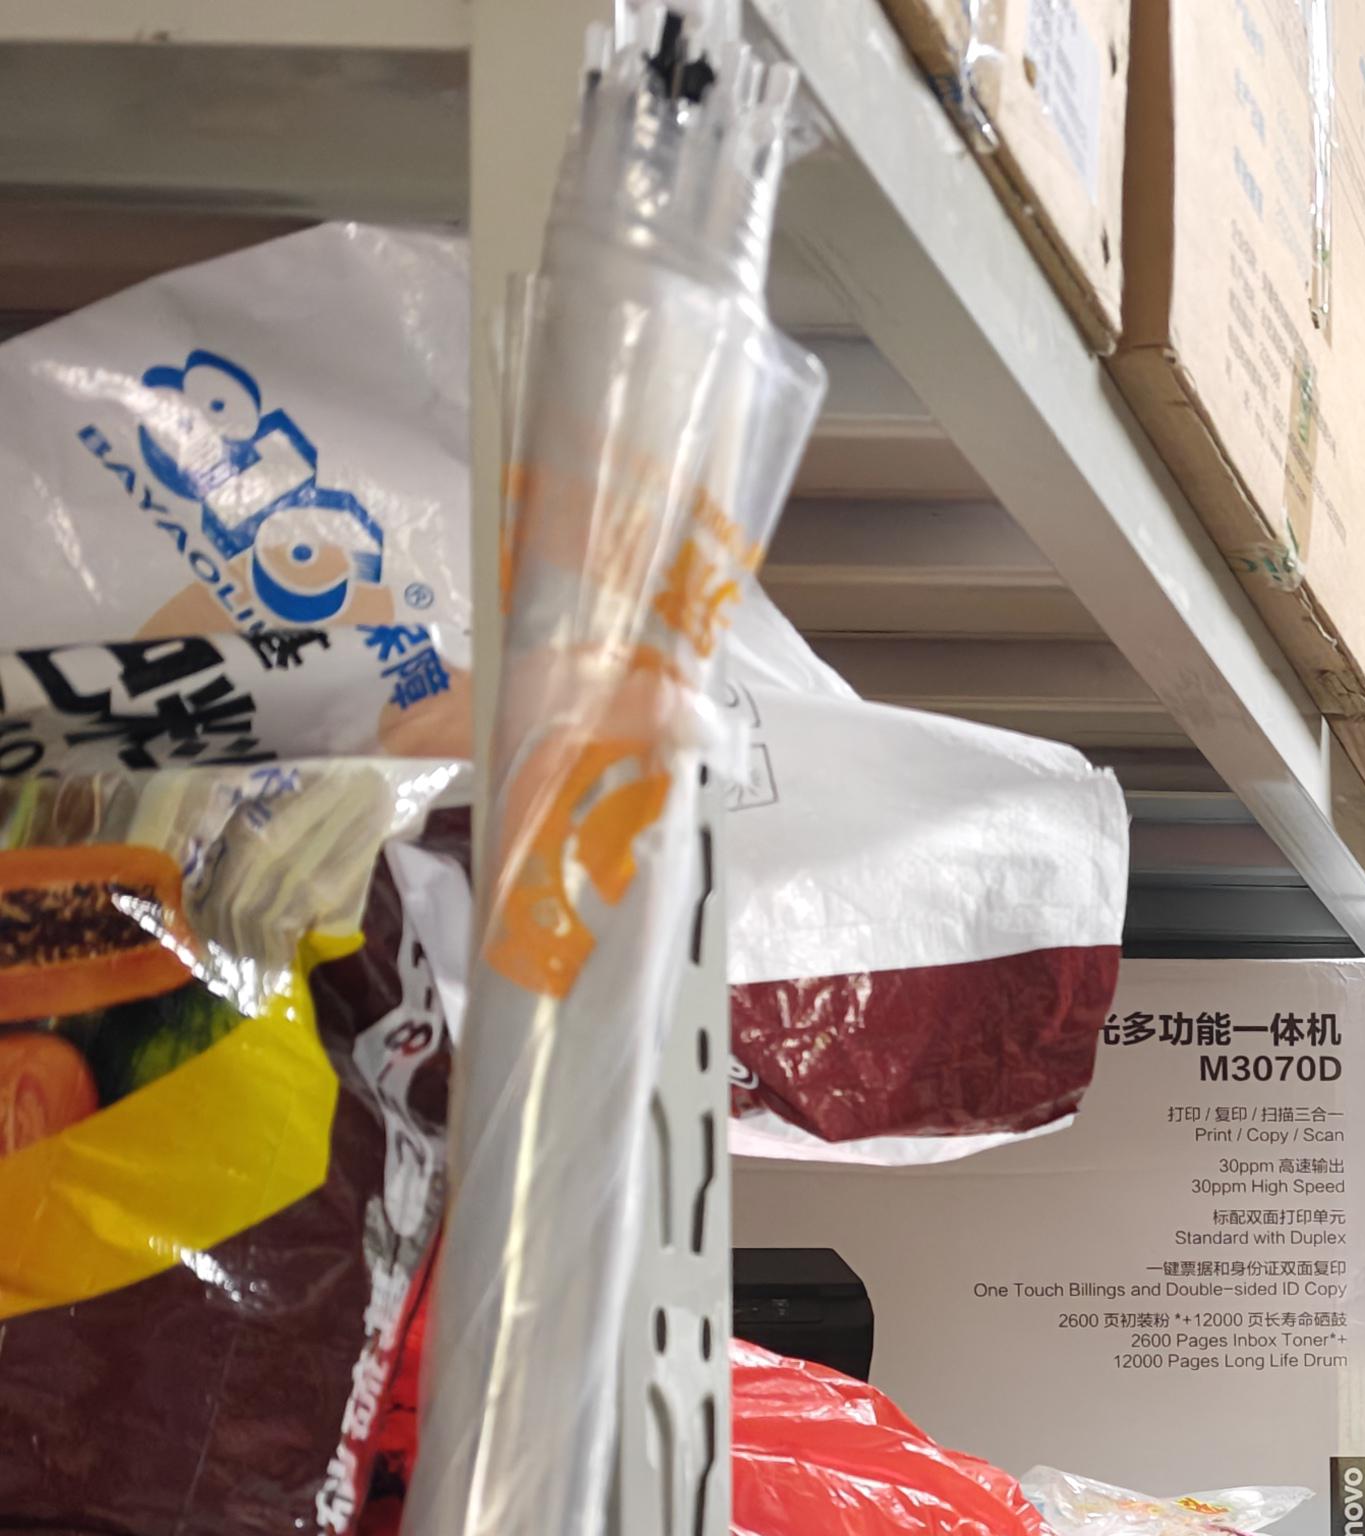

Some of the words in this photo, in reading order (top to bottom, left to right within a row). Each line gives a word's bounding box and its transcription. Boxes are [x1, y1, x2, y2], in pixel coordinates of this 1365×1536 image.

[1200, 1055, 1342, 1081] M3070D
[1168, 1106, 1200, 1122] 打印
[1215, 1106, 1247, 1122] 复印
[1261, 1106, 1344, 1122] 扫描三合一
[1195, 1128, 1232, 1142] Print
[1246, 1128, 1289, 1145] Copy
[1303, 1128, 1344, 1142] Scan
[1219, 1159, 1274, 1176] 30ppm
[1279, 1158, 1344, 1174] 高速输出
[1191, 1179, 1247, 1196] 30ppm
[1252, 1179, 1288, 1197] High
[1293, 1179, 1345, 1196] Speed
[1213, 1209, 1346, 1225] 标配双面打印单元
[1175, 1230, 1248, 1245] Standard
[1253, 1230, 1285, 1245] with
[1290, 1230, 1346, 1247] Duplex
[1147, 1260, 1347, 1277] 一键票据和身份证双面复印
[974, 1282, 1008, 1297] One
[1013, 1282, 1064, 1297] Touch
[1069, 1282, 1125, 1299] Billings
[1130, 1282, 1161, 1297] and
[1166, 1282, 1277, 1297] Double-sided
[1282, 1282, 1299, 1297] ID
[1304, 1282, 1347, 1299] Copy
[1058, 1313, 1099, 1328] 2600
[1104, 1312, 1169, 1329] 页初装粉
[1248, 1312, 1348, 1328] 页长寿命硒鼓
[1131, 1333, 1171, 1348] 2600
[1176, 1333, 1228, 1352] Pages
[1233, 1333, 1277, 1348] Inbox
[1114, 1354, 1163, 1369] 12000
[1168, 1354, 1219, 1372] Pages
[1224, 1354, 1265, 1371] Long
[1270, 1353, 1299, 1368] Life
[1303, 1353, 1348, 1368] Drum
